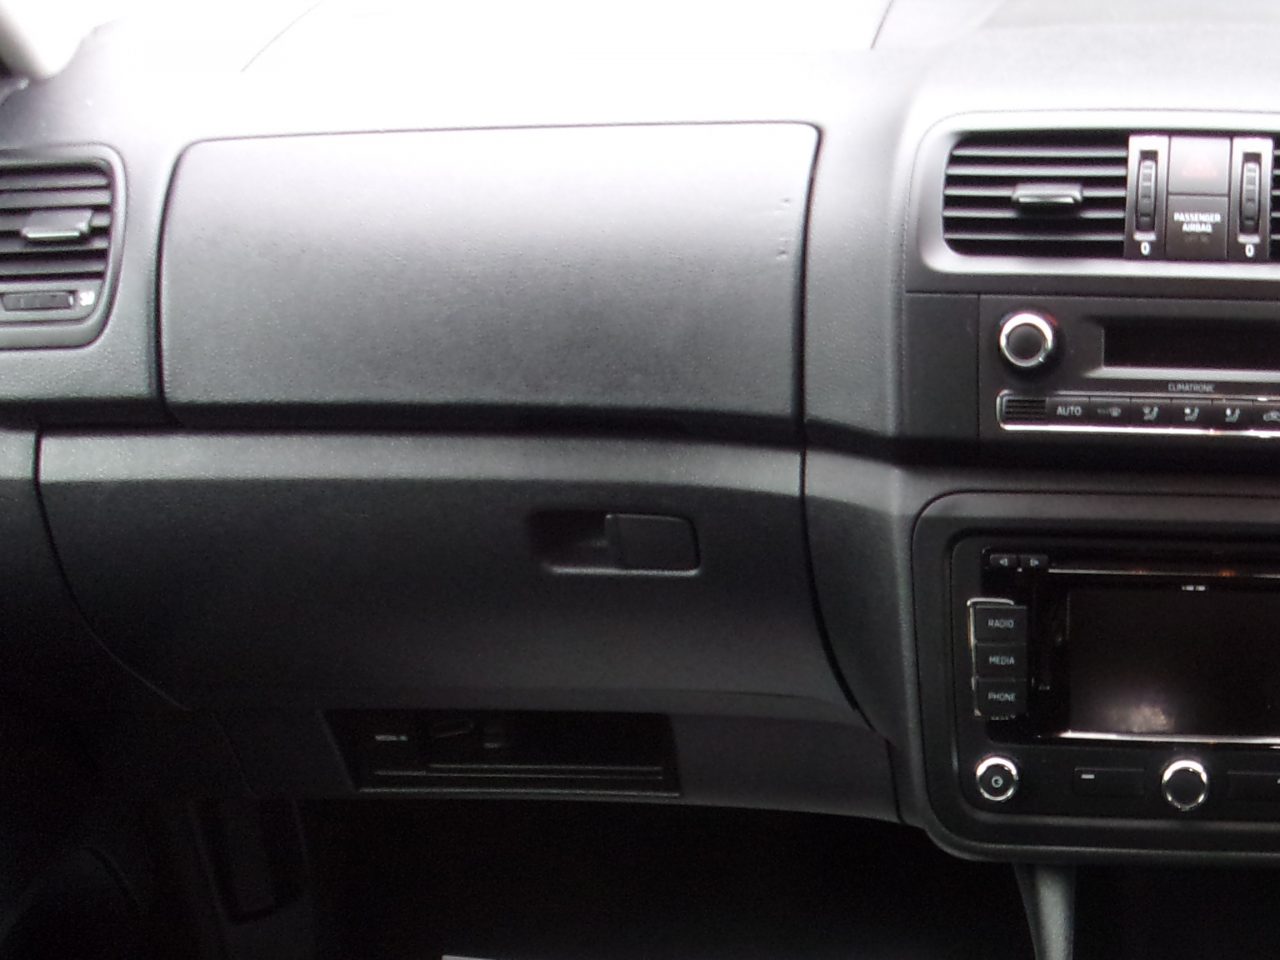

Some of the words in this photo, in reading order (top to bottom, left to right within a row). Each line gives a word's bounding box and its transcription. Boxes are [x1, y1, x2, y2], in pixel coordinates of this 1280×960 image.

[1173, 212, 1221, 222] PASSENGER
[1182, 222, 1213, 233] AIRBAG
[1167, 383, 1216, 393] CLIMATRONIC
[1056, 406, 1082, 416] AUTO
[987, 619, 1015, 629] RADIO
[988, 656, 1015, 665] MEDIA
[987, 692, 1016, 702] PHONE
